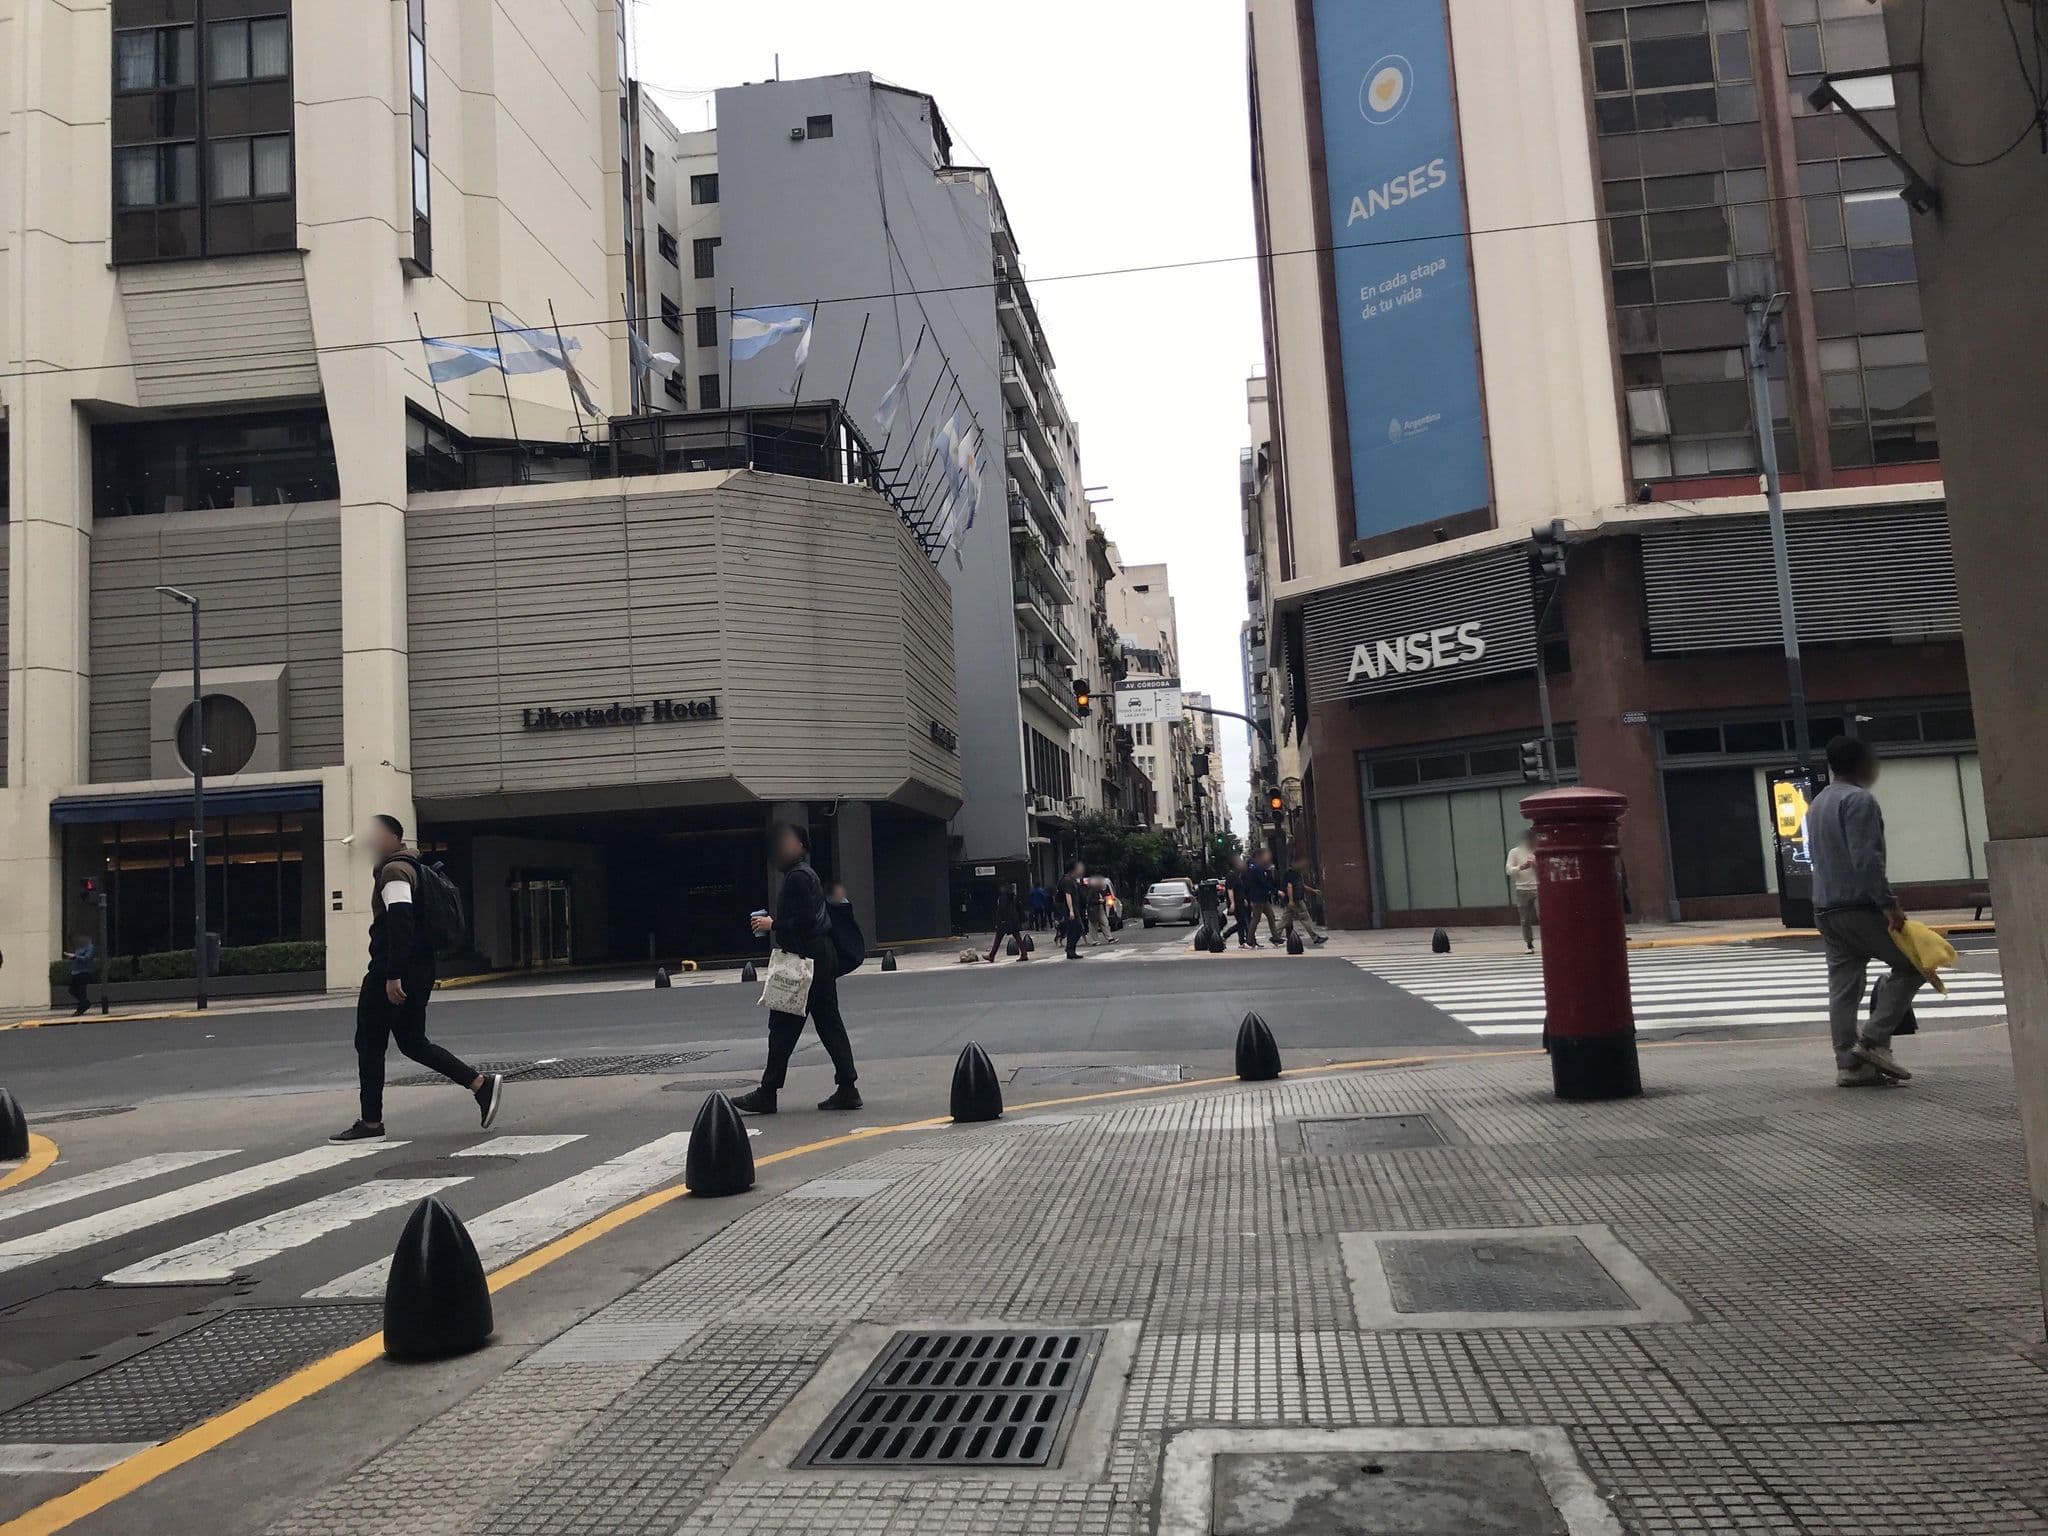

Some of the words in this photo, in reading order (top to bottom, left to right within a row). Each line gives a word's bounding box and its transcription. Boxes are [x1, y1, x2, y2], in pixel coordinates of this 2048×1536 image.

[1347, 158, 1447, 228] ANSES
[1360, 286, 1377, 301] En
[1379, 272, 1408, 294] cada
[1410, 258, 1447, 281] etapa
[1361, 304, 1377, 320] de
[1379, 298, 1393, 312] tu
[1395, 286, 1423, 306] vida
[1345, 621, 1486, 683] ANSES
[522, 702, 647, 731] Libertador
[652, 696, 718, 721] Hotel
